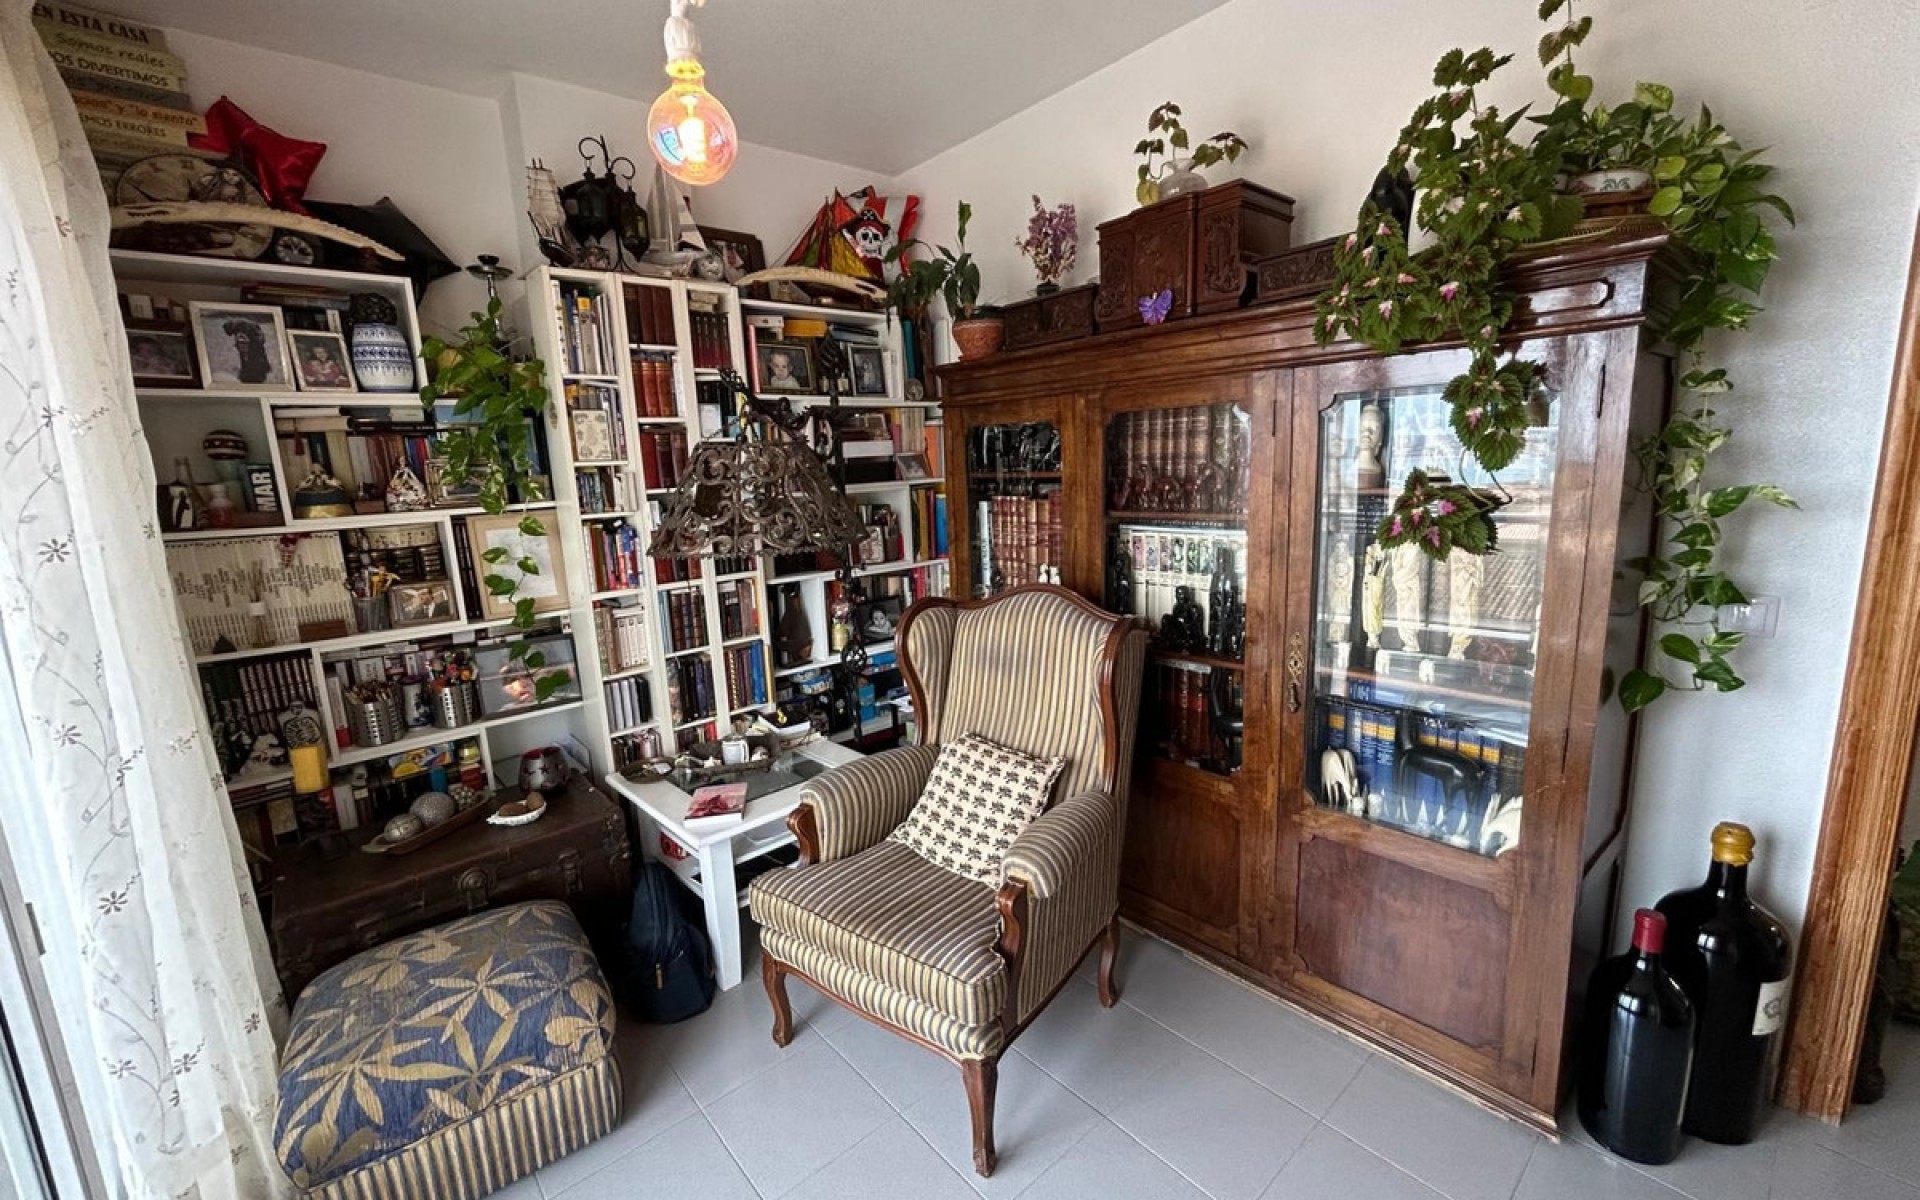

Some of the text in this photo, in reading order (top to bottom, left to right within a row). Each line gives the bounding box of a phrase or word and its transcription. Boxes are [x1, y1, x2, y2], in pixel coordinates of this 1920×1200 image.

[60, 9, 104, 32] ESTA
[108, 22, 149, 44] CASA
[56, 32, 165, 68] Somos reales
[78, 57, 168, 87] DIVERTIMOS
[251, 471, 278, 511] MAR
